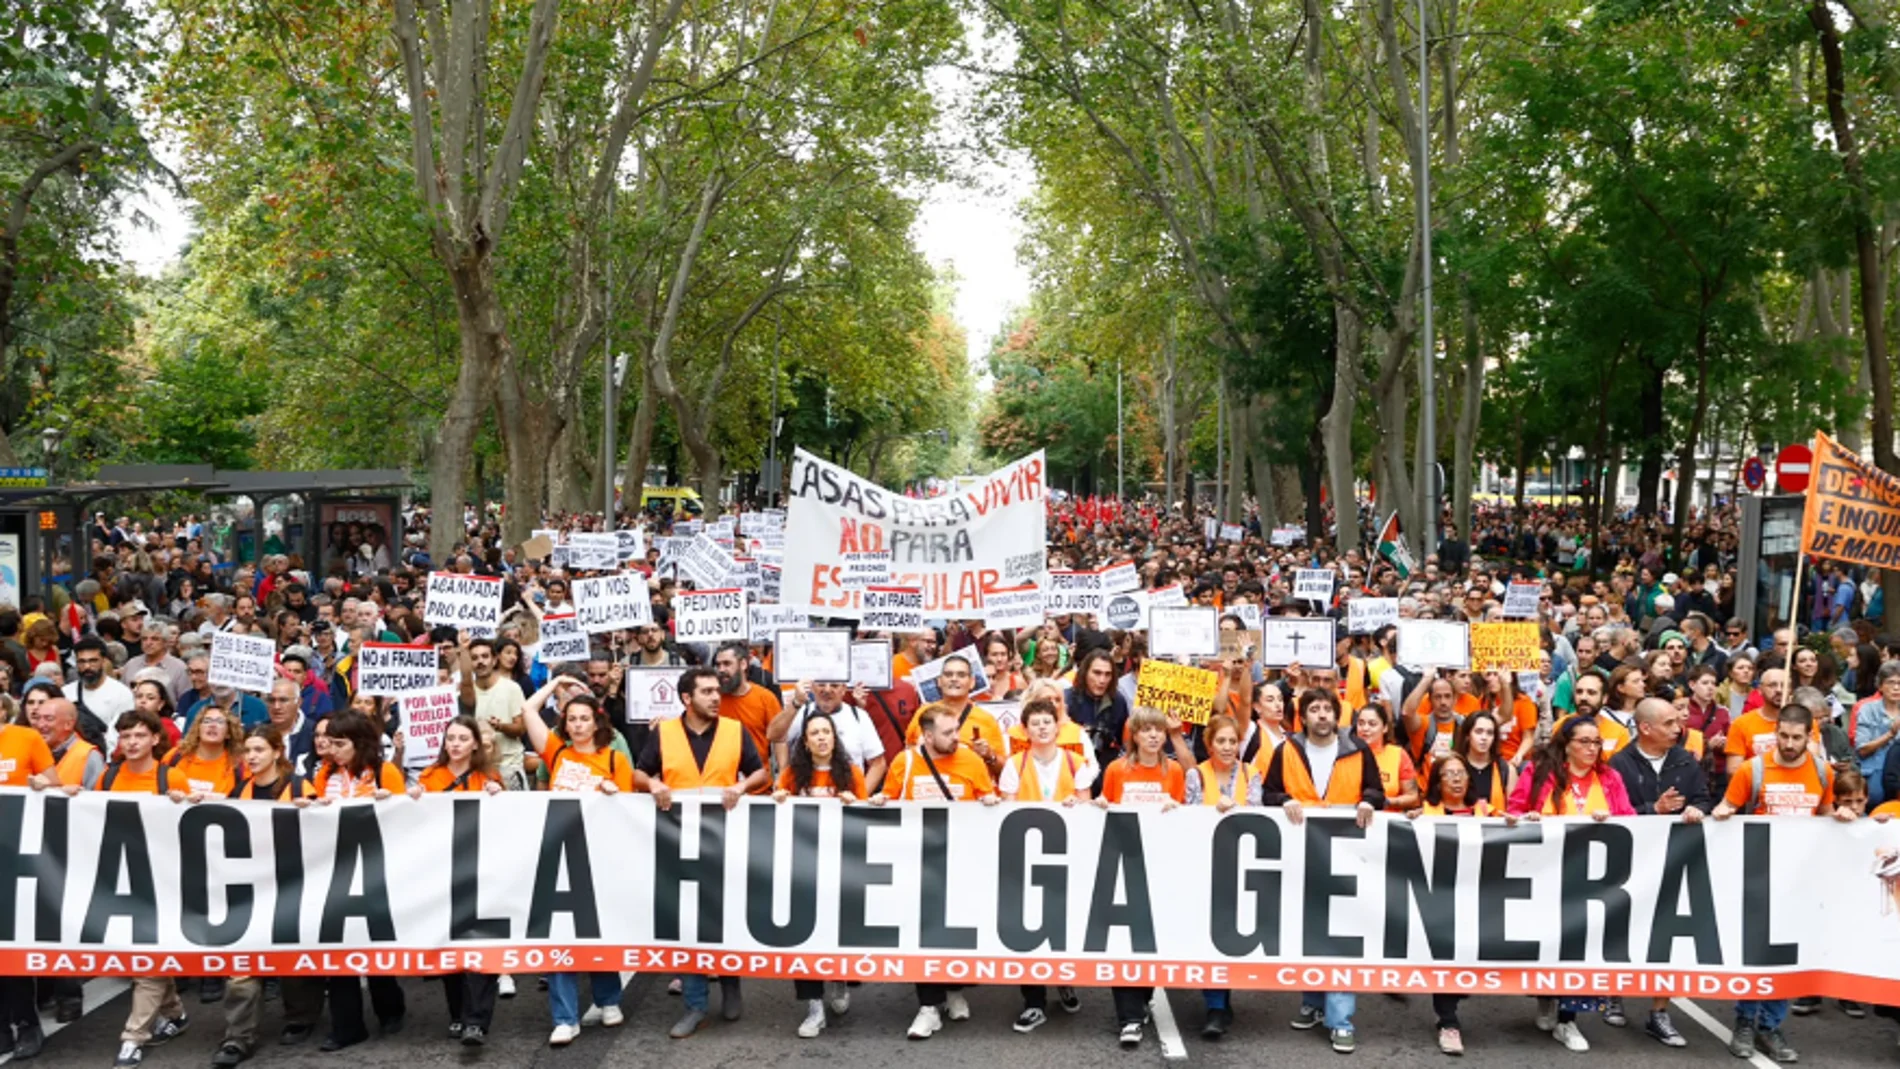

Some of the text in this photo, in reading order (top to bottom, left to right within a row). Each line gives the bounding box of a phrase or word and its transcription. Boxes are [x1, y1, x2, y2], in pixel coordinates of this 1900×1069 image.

[1825, 469, 1856, 496] DE
[337, 510, 376, 522] BOSS
[892, 498, 970, 526] PARA
[1820, 501, 1835, 524] E
[840, 517, 974, 563] NO PARA
[1811, 530, 1843, 554] DE
[430, 578, 500, 598] ACAMPADA
[606, 578, 630, 597] NOS
[864, 594, 876, 607] NO
[888, 594, 923, 608] FRAUDE
[1109, 602, 1136, 614] STOP
[427, 601, 496, 622] PRO CASA
[678, 620, 695, 636] LO
[362, 651, 435, 667] NO al FRAUDE
[1503, 647, 1531, 658] CASAS
[404, 693, 454, 709] POR UNA
[410, 706, 452, 722] HUELGA
[425, 736, 439, 748] YA
[0, 795, 1798, 967] HACIA LA HUELGA GENERAL
[26, 953, 183, 972] BAJADA
[203, 955, 275, 972] DEL
[294, 951, 483, 974] ALQUILER
[503, 949, 574, 968] 50%
[623, 949, 904, 977] EXPROPIACIÓN
[924, 959, 1076, 980] FONDOS
[1096, 963, 1229, 983] BUITRE
[1277, 967, 1502, 989] CONTRATOS
[1520, 970, 1775, 995] INDEFINIDOS
